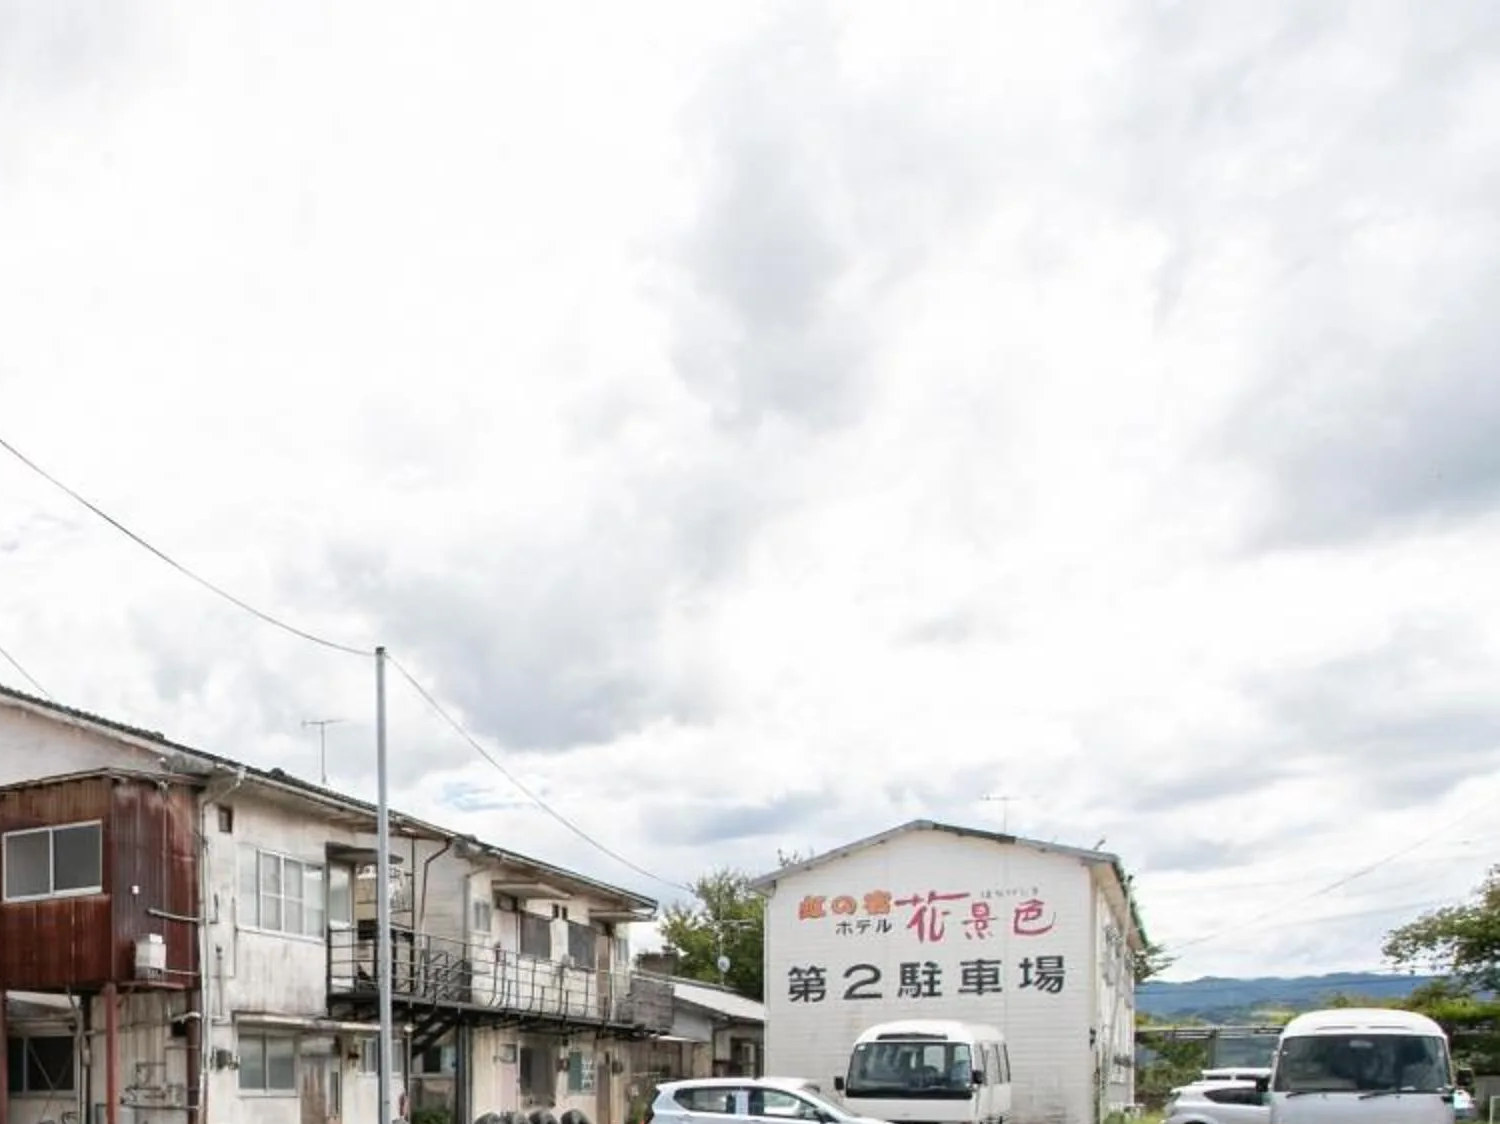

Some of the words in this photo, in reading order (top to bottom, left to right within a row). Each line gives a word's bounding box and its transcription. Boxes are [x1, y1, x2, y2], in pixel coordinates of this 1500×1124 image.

[835, 918, 892, 935] ホテル
[894, 889, 1057, 944] 花景色
[787, 955, 1065, 1003] 第2駐車場
